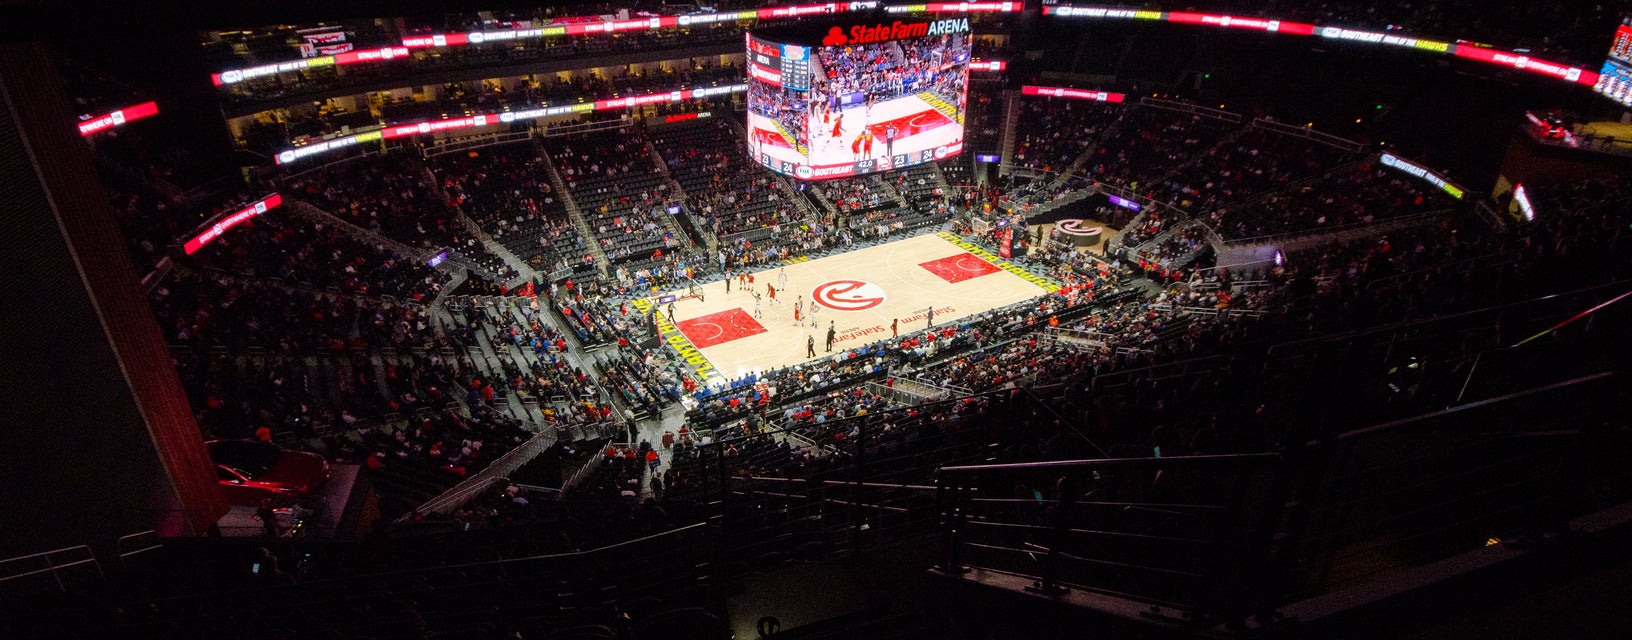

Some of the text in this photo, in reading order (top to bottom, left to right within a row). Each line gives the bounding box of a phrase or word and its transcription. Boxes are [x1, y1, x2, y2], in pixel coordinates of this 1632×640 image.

[1072, 7, 1107, 17] SOUTHEAST
[927, 18, 969, 36] ARENA
[484, 31, 516, 41] SOUTHEAST
[542, 26, 565, 36] HAWKS
[1340, 29, 1385, 43] SOUTHEAST
[1415, 39, 1449, 53] HAWKS
[357, 50, 381, 60] STREAM
[242, 65, 278, 79] SOUTHEAST
[307, 56, 335, 67] HAWKS
[705, 86, 731, 96] SOUTHEAST
[606, 99, 626, 108] STREAM
[515, 109, 547, 120] SOUTHEAST
[572, 103, 595, 112] HAWKS
[396, 126, 418, 136] STREAM
[430, 119, 466, 130] EVERYWHERE
[294, 142, 329, 158] SOUTHEAST
[356, 131, 382, 142] HAWKS
[762, 154, 769, 164] 23
[923, 149, 933, 159] 24
[858, 160, 873, 169] 42.0
[894, 155, 905, 166] 23
[783, 162, 793, 173] 24
[814, 165, 854, 177] SOUTHEAST
[1394, 159, 1428, 178] SOUTHEAST
[936, 231, 999, 263] ATLANTA
[998, 261, 1063, 293] HAWKS
